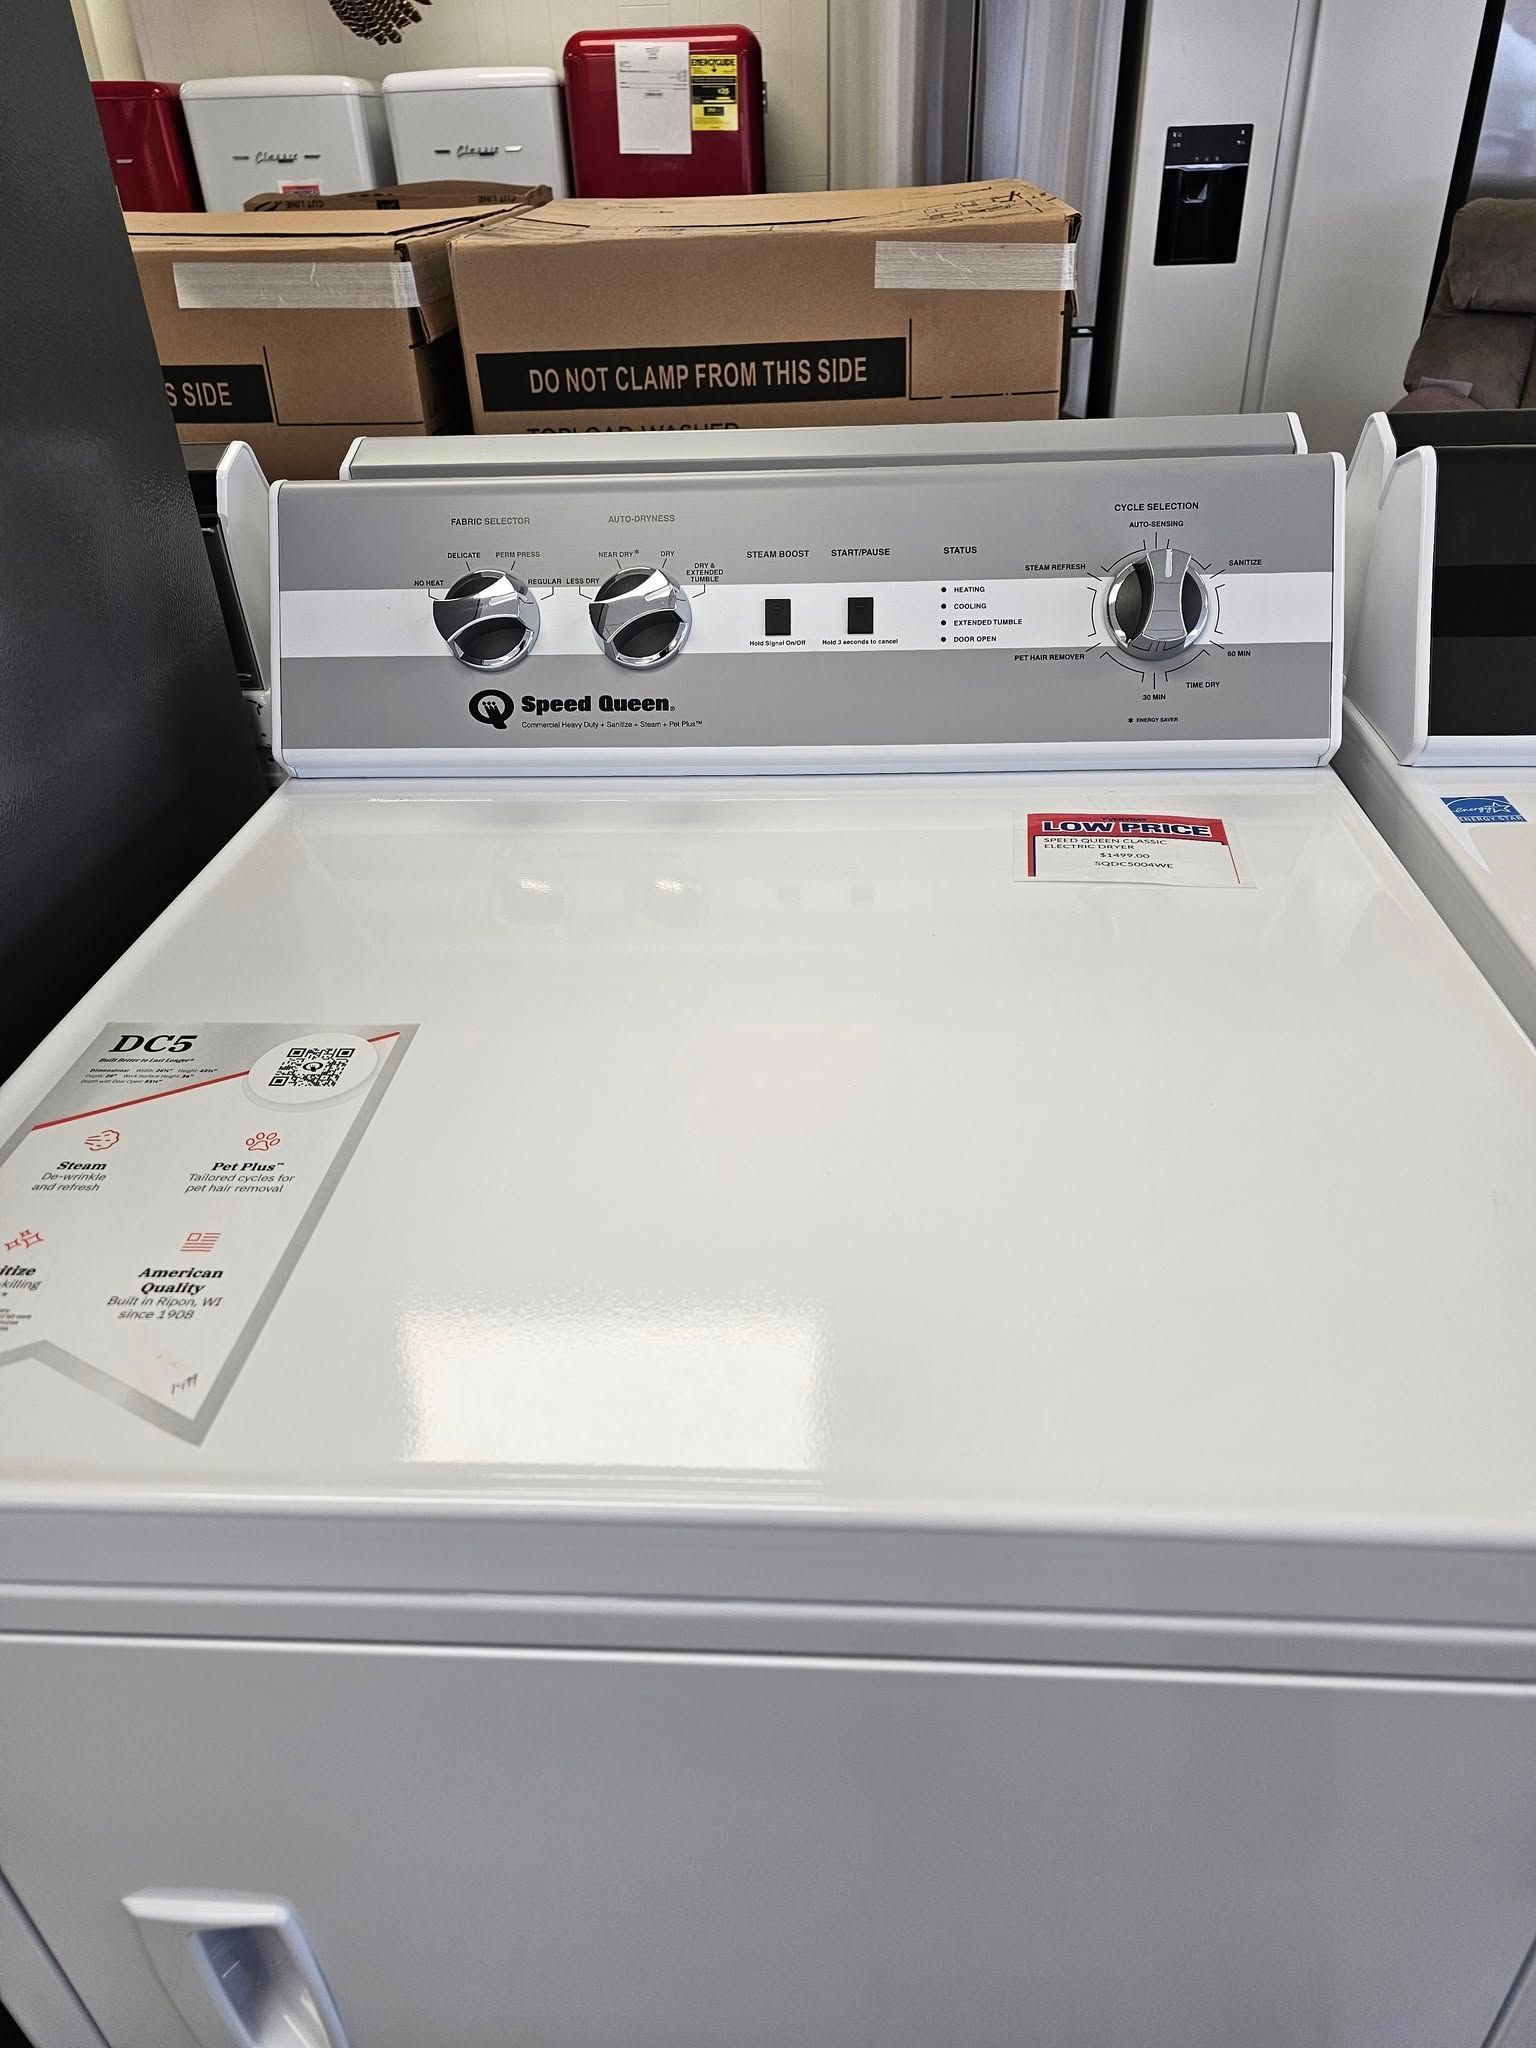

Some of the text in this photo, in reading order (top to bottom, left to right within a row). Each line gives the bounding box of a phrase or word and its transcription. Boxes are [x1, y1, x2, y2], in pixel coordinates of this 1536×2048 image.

[529, 357, 867, 394] DO NOT CLAMP FROM THIS SIDE
[183, 382, 232, 406] SIDE
[1114, 502, 1199, 511] CYCLE SELECTION
[451, 517, 530, 526] FABRIC SELECTOR
[608, 514, 675, 523] AUTO-DRYNESS
[1129, 520, 1184, 528] AUTO-SENSING
[746, 549, 810, 558] STEAM BOOST
[831, 548, 890, 557] START/PAUSE
[943, 546, 977, 554] STATUS
[953, 602, 987, 610] COOLING
[521, 695, 591, 716] Speed
[561, 721, 583, 729] Heavy
[584, 721, 599, 729] Duty
[669, 720, 680, 728] Pet
[1044, 822, 1211, 836] LOW PRICE
[1095, 861, 1174, 869] SQDC5004WE
[108, 1034, 198, 1053] DC5
[56, 1161, 107, 1170] Steam
[211, 1162, 239, 1171] Pet
[41, 1172, 107, 1181] De-wrinkle
[189, 1173, 296, 1184] Tailored cycles for
[31, 1182, 100, 1191] and refresh
[184, 1184, 284, 1194] pet hair removal
[138, 1267, 224, 1278] American
[0, 1279, 42, 1291] killing
[140, 1282, 206, 1296] Quality
[107, 1295, 224, 1308] Built in Ripon, WI
[117, 1309, 196, 1320] since 1908
